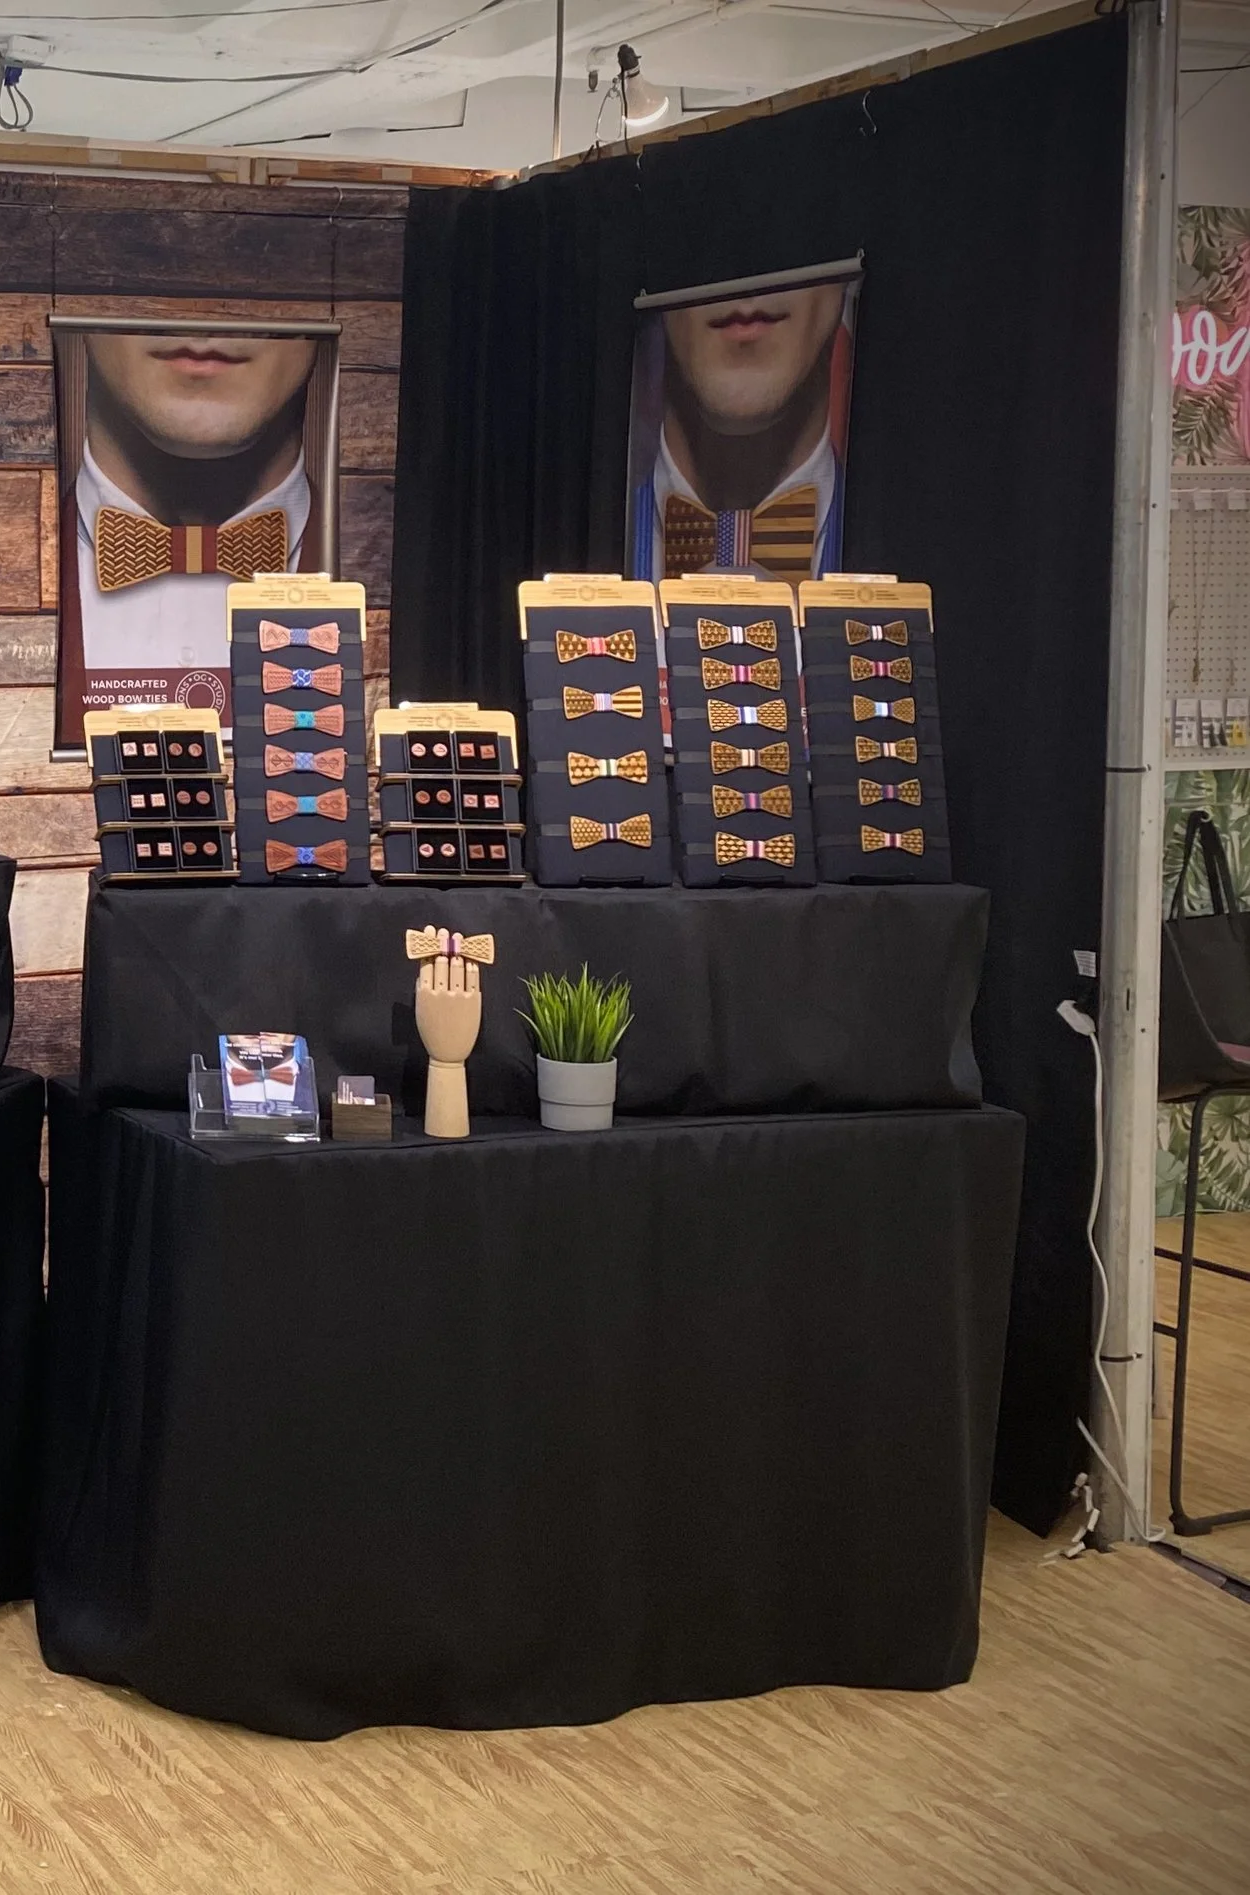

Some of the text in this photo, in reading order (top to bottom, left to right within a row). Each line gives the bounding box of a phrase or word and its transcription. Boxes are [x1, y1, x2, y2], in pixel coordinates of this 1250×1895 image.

[90, 679, 168, 689] HANDCRAFTED
[82, 694, 168, 704] WOOD BOW TIES
